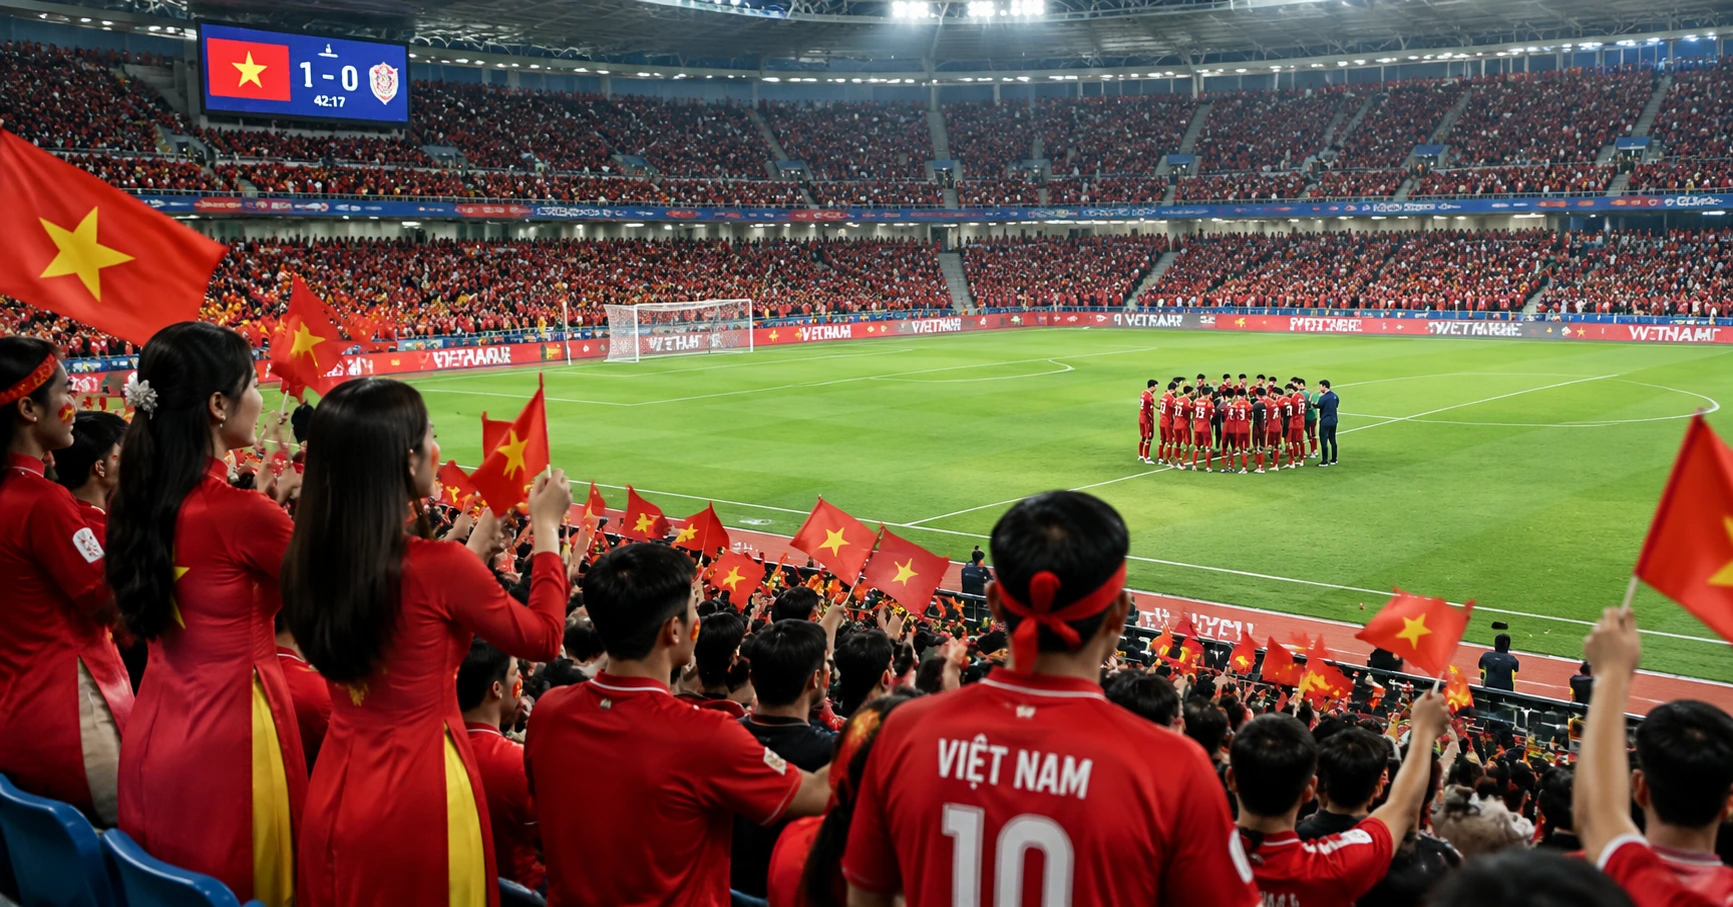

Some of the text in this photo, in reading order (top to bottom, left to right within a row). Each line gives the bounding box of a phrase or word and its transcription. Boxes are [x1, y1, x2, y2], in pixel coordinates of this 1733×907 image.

[300, 61, 313, 88] 1
[341, 65, 359, 91] 0
[313, 95, 346, 108] 42:17
[938, 733, 1093, 800] VIỆT NAM
[941, 802, 1075, 907] 10
